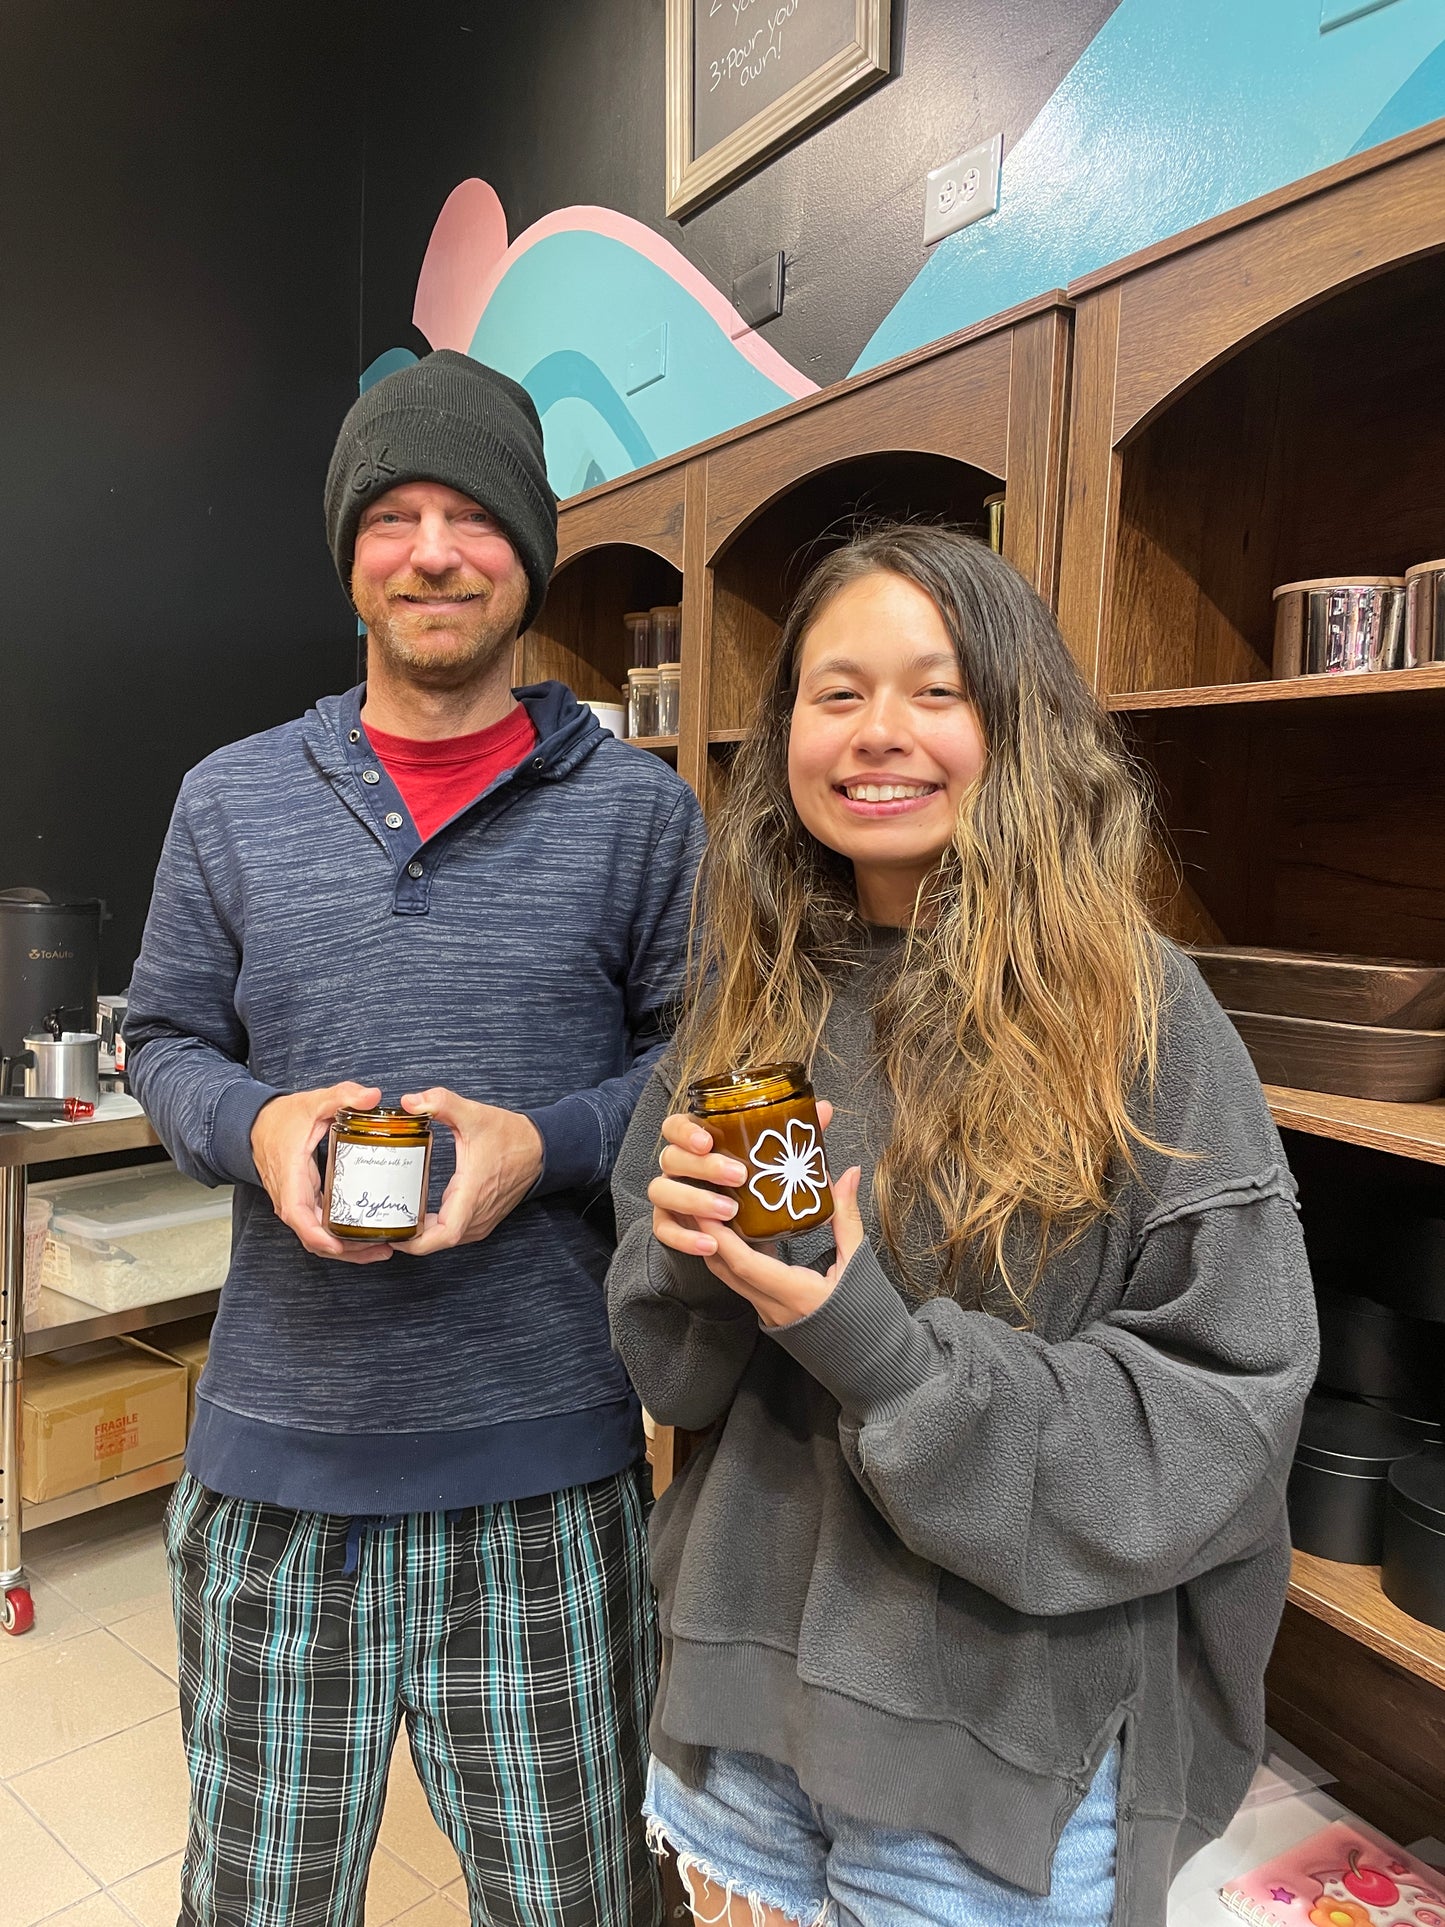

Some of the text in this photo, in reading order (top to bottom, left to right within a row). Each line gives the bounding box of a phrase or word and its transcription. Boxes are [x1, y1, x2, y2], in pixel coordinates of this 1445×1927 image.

[740, 31, 782, 86] own!
[40, 950, 74, 959] ToAuto
[356, 1191, 409, 1218] Sylvia
[94, 1412, 138, 1436] FRAGILE
